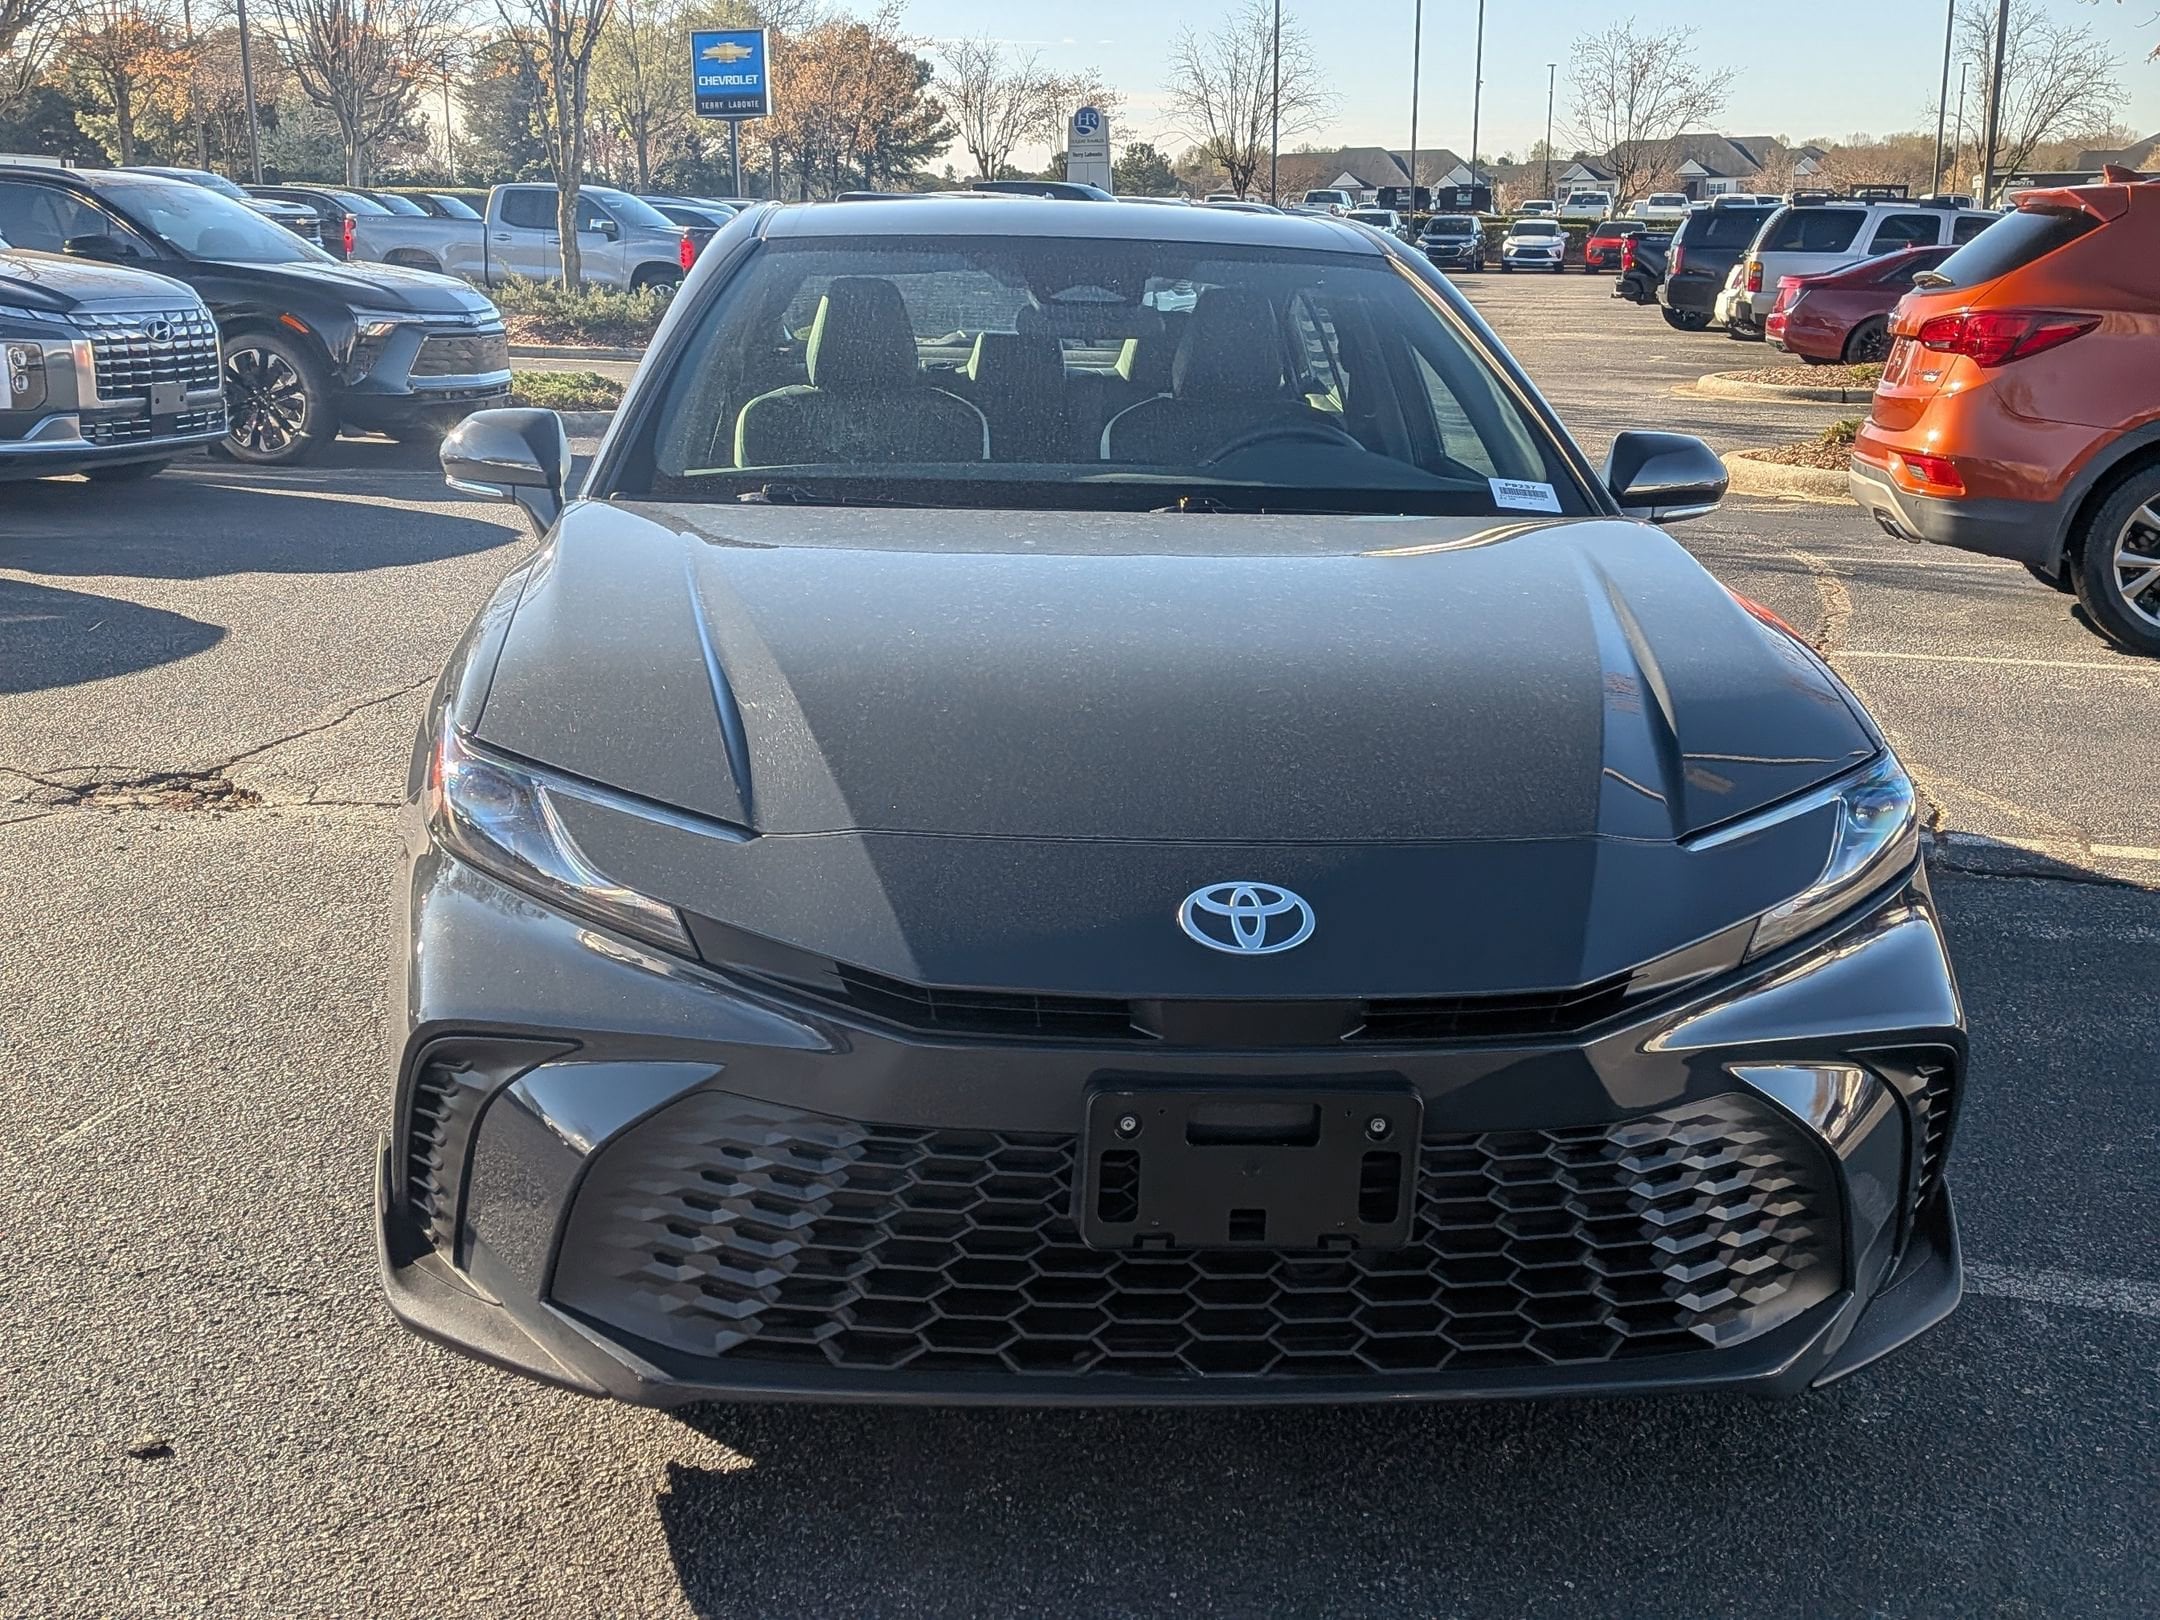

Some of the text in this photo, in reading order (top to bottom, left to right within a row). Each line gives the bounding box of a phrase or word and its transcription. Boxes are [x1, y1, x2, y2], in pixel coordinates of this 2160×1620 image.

[698, 74, 759, 86] CHEVROLET
[701, 100, 760, 109] TERRY LABONTE
[1077, 112, 1097, 125] HR
